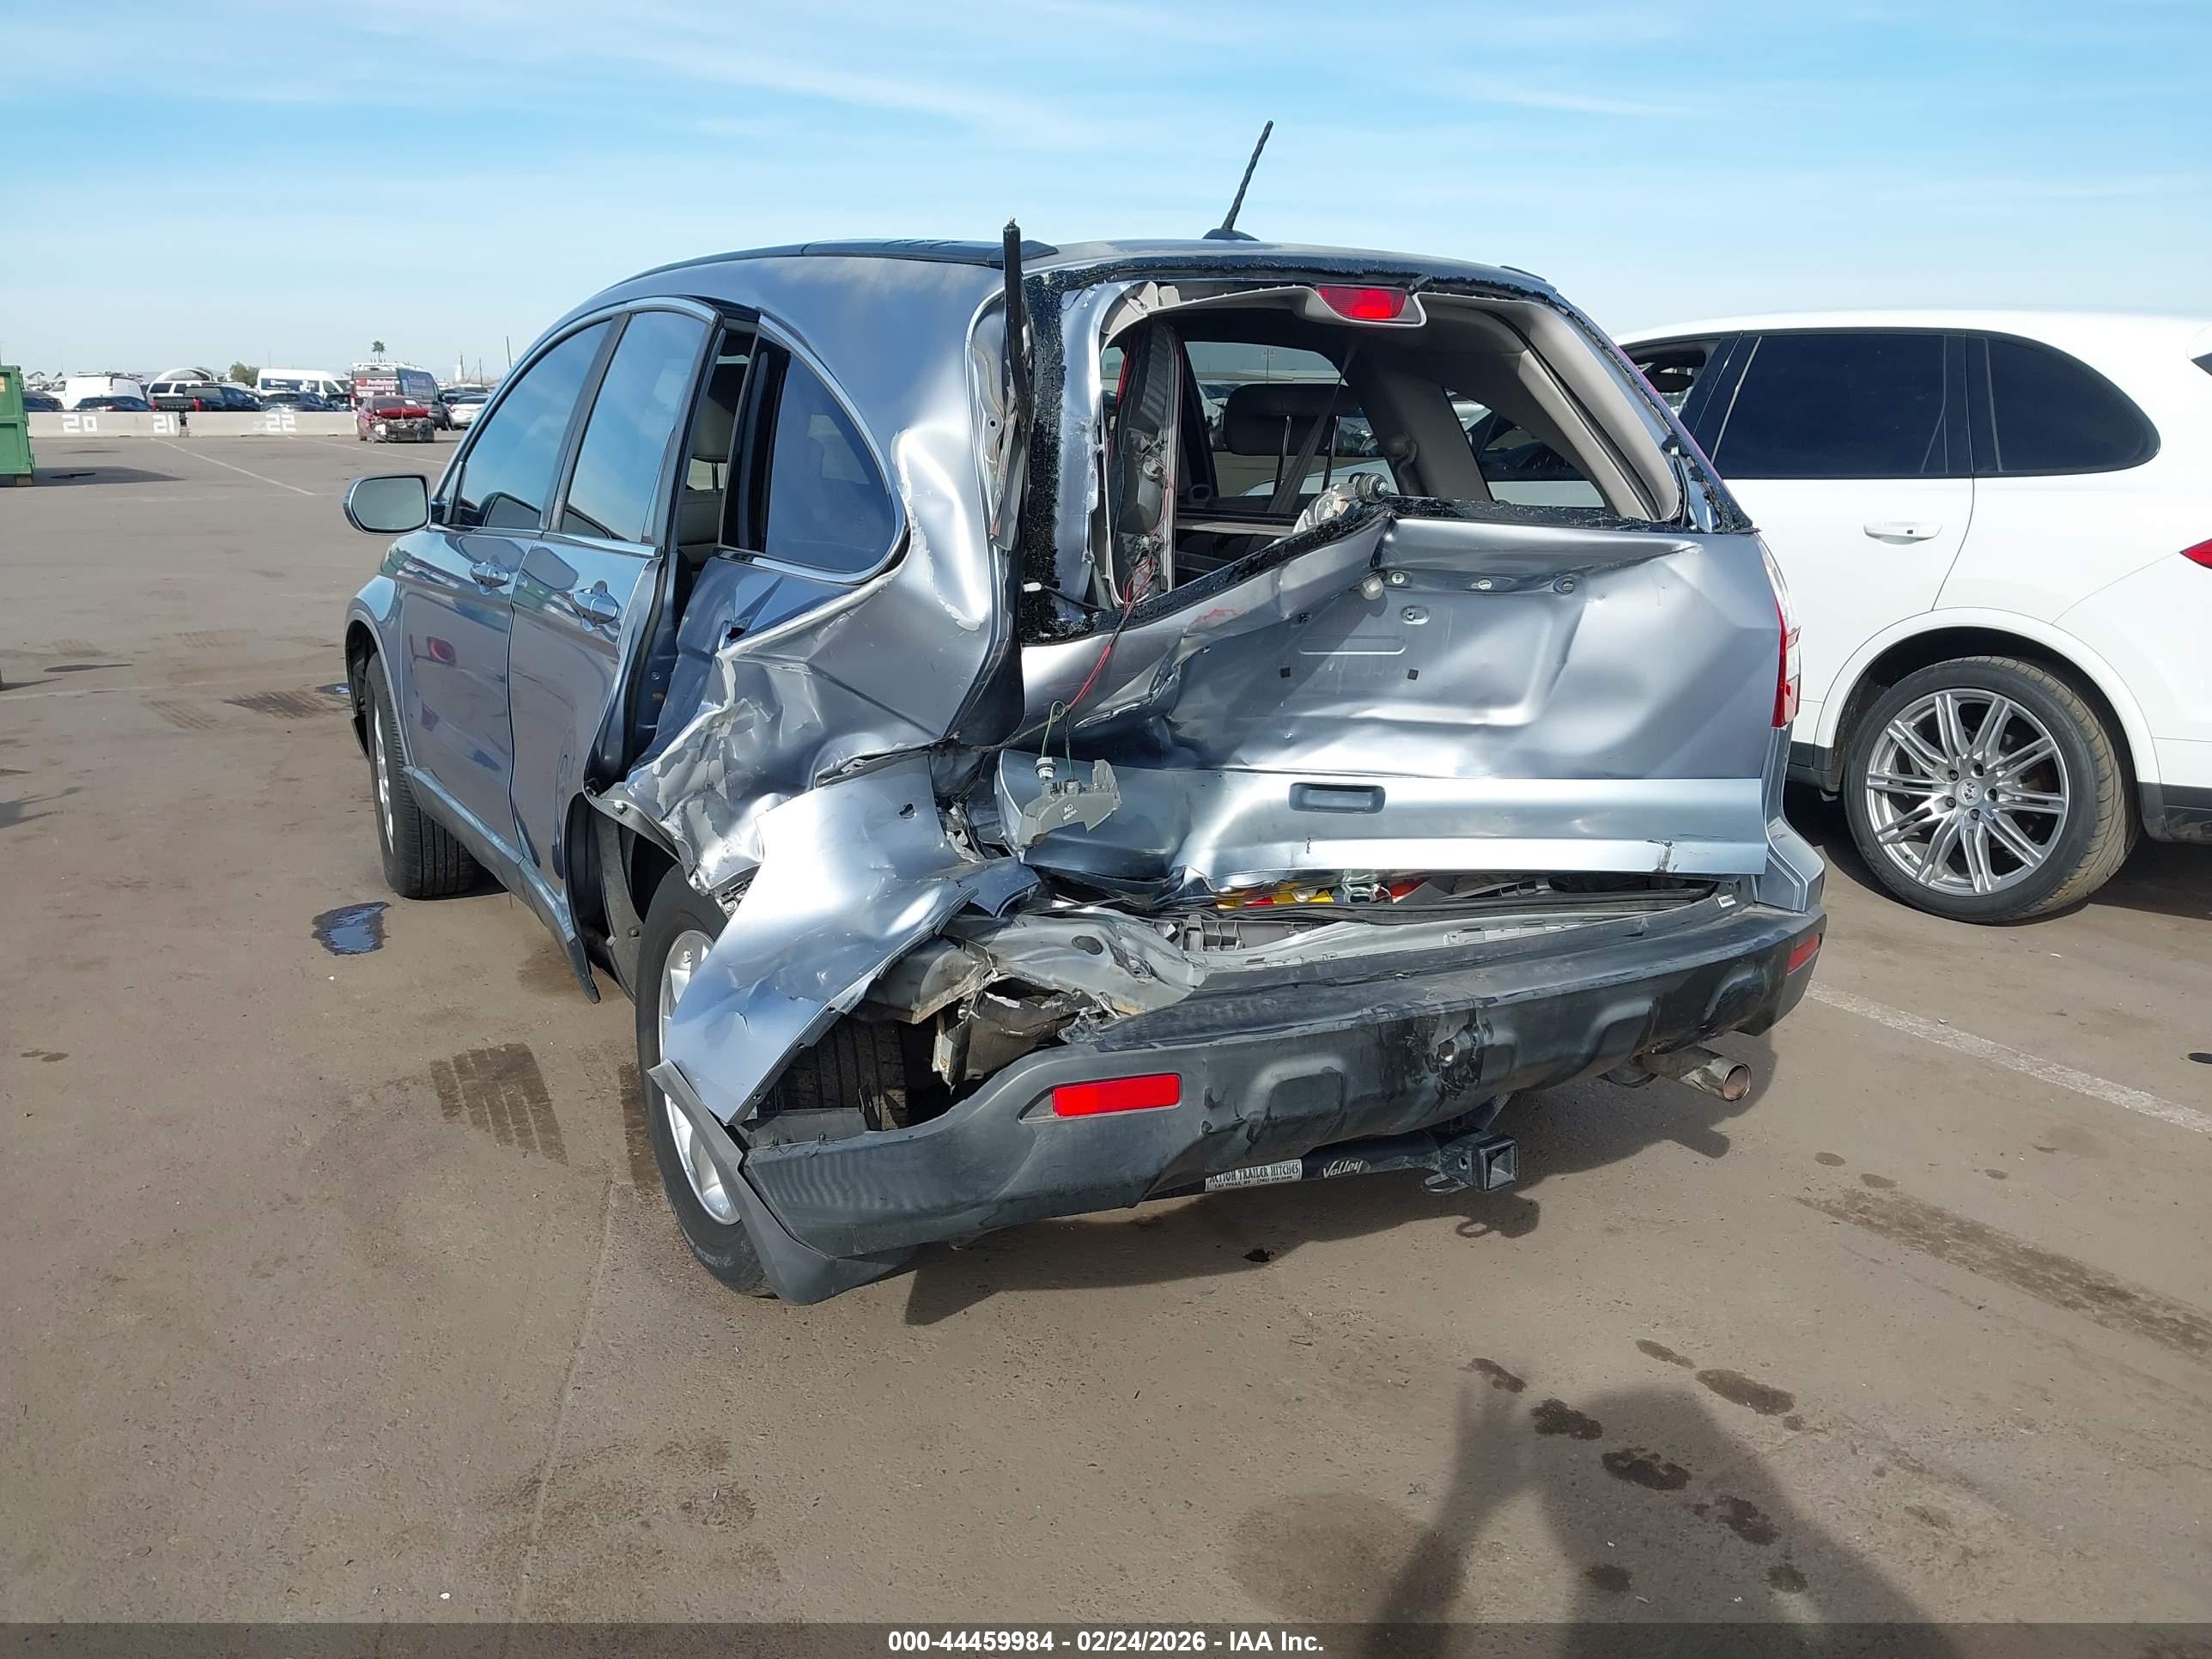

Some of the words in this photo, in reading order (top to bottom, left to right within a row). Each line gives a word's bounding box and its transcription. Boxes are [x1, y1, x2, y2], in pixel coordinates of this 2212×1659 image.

[61, 414, 98, 434] 20
[152, 414, 175, 434] 21
[265, 413, 296, 432] 22
[1237, 1166, 1268, 1180] TRAILER
[1270, 1163, 1299, 1176] HITCHES
[1322, 1160, 1364, 1179] Valley
